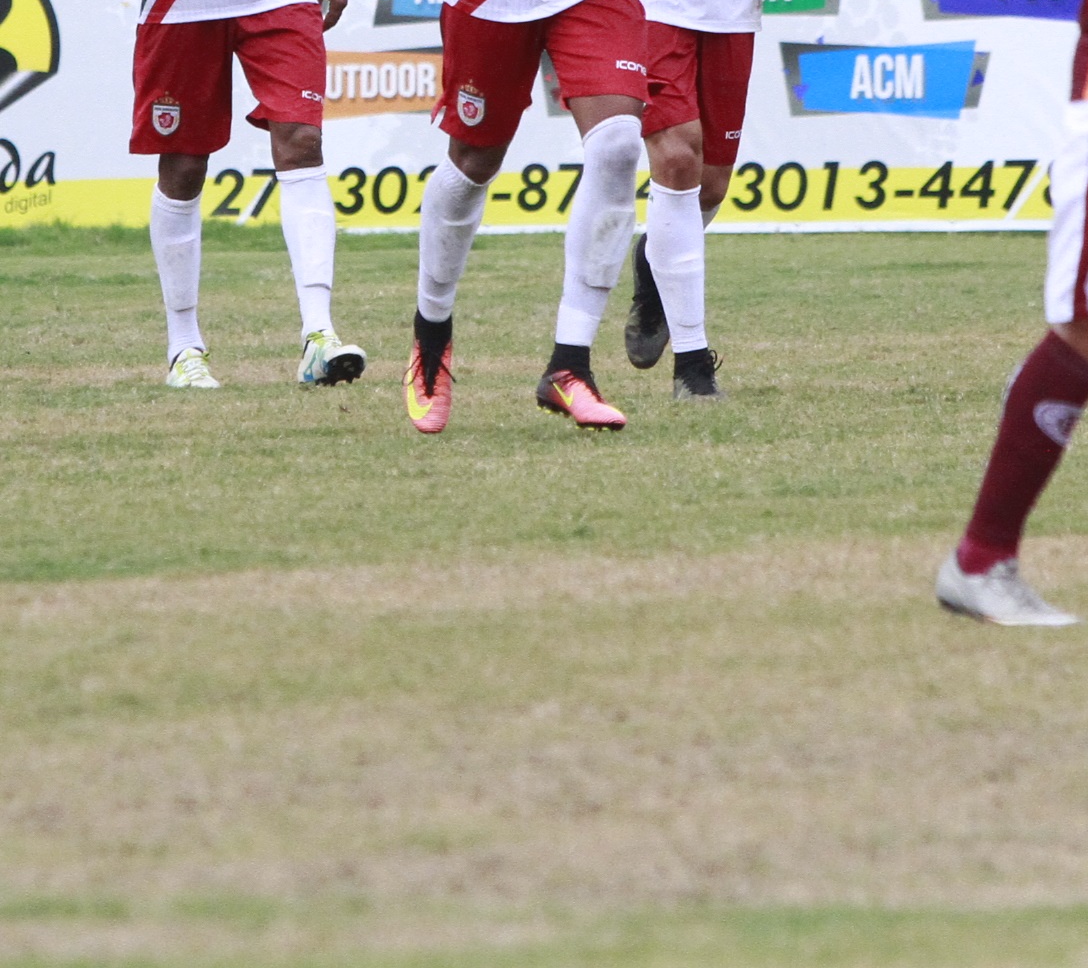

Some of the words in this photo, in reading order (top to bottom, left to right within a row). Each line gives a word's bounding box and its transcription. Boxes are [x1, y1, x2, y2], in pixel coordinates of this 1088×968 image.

[325, 62, 436, 99] UTDOOR
[850, 54, 925, 101] ACM
[4, 189, 52, 215] digital
[732, 159, 1053, 211] 3013-447
